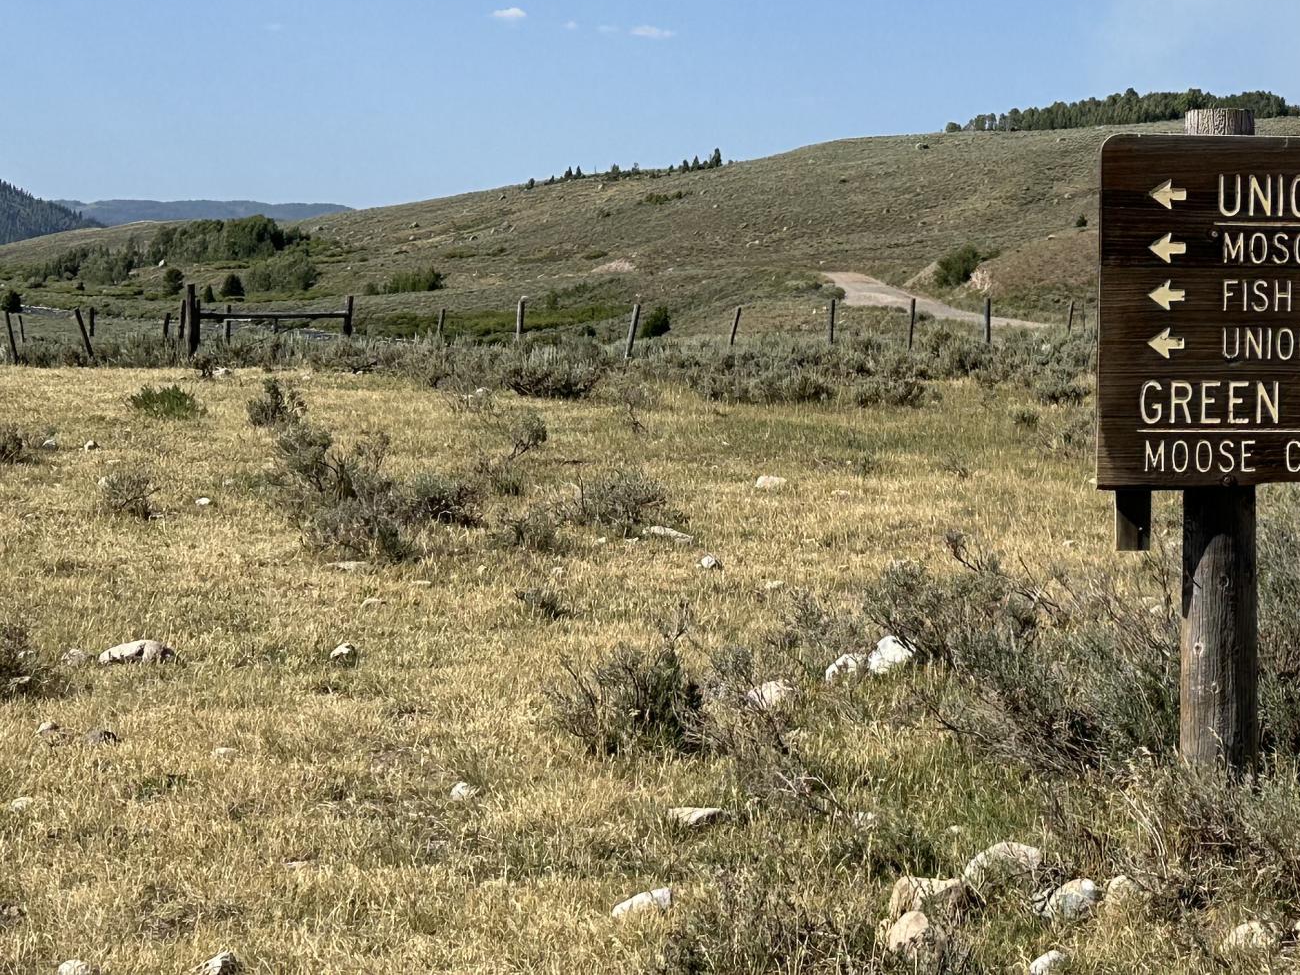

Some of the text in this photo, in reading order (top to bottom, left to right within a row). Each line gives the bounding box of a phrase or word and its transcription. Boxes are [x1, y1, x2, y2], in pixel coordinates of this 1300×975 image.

[1222, 279, 1293, 312] FISH
[1139, 380, 1280, 425] GREEN
[1144, 440, 1257, 473] MOOSE
